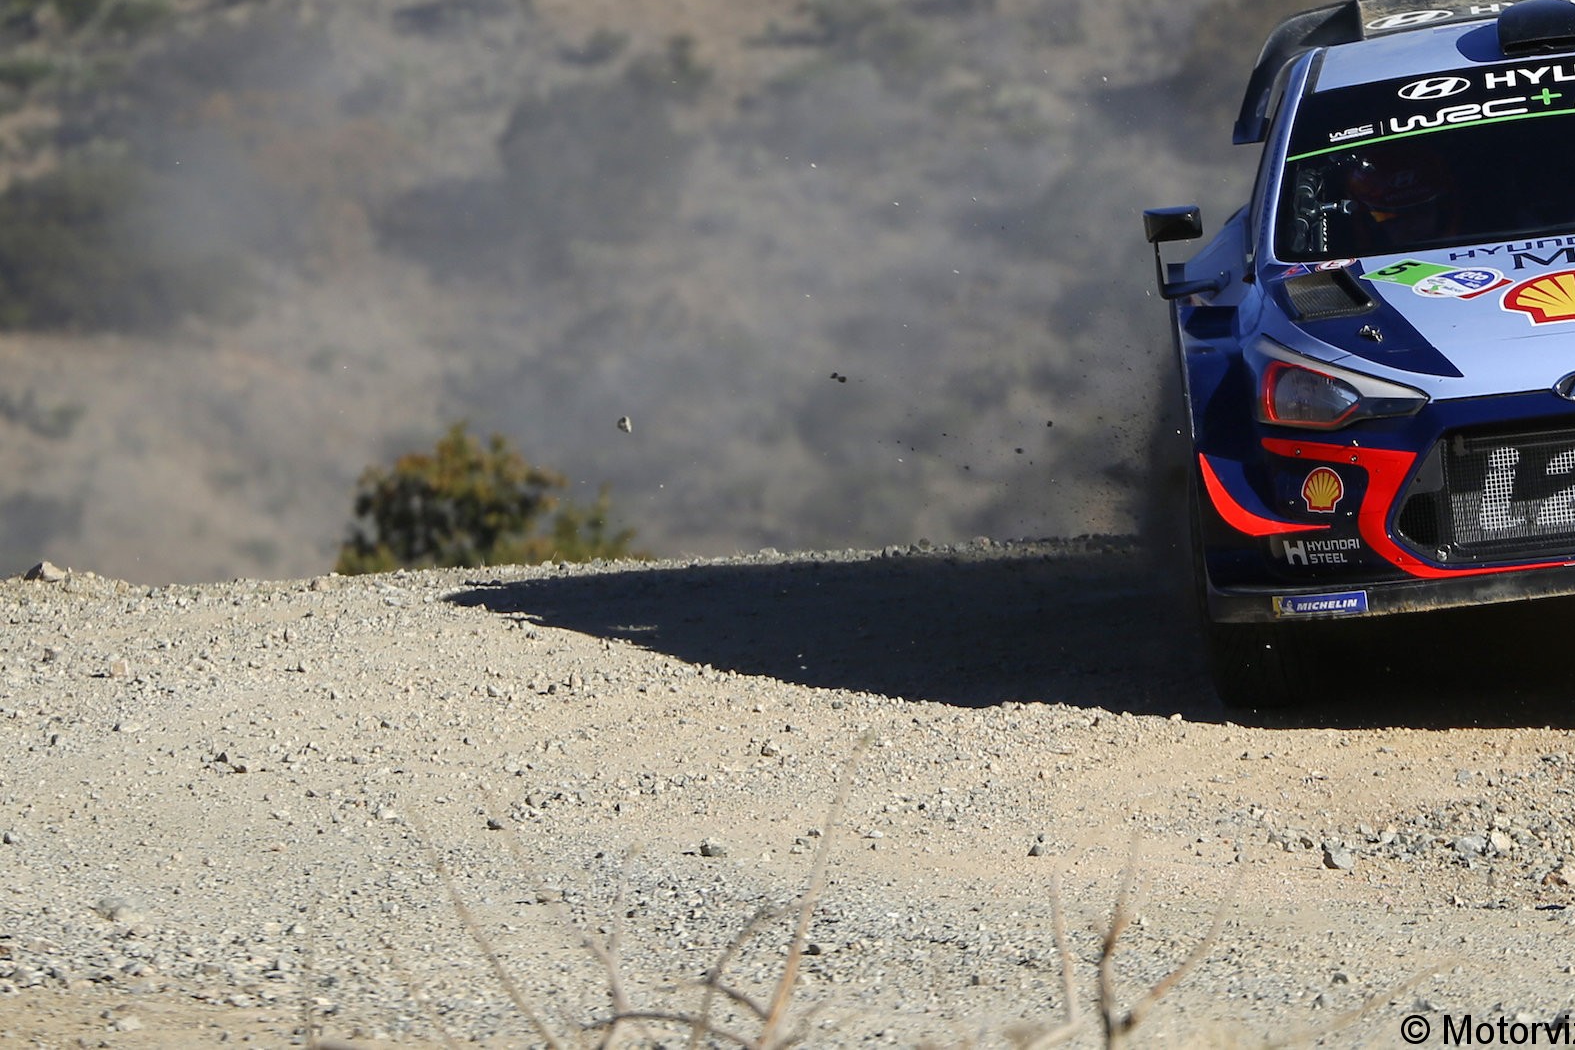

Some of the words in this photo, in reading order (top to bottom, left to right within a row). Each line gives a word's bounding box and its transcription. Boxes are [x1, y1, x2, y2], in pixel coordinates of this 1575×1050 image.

[1329, 124, 1374, 142] WRC
[1377, 261, 1421, 276] 5
[1307, 538, 1361, 552] HYUNDAI
[1309, 552, 1348, 564] STEEL
[1296, 598, 1358, 612] MICHELIN
